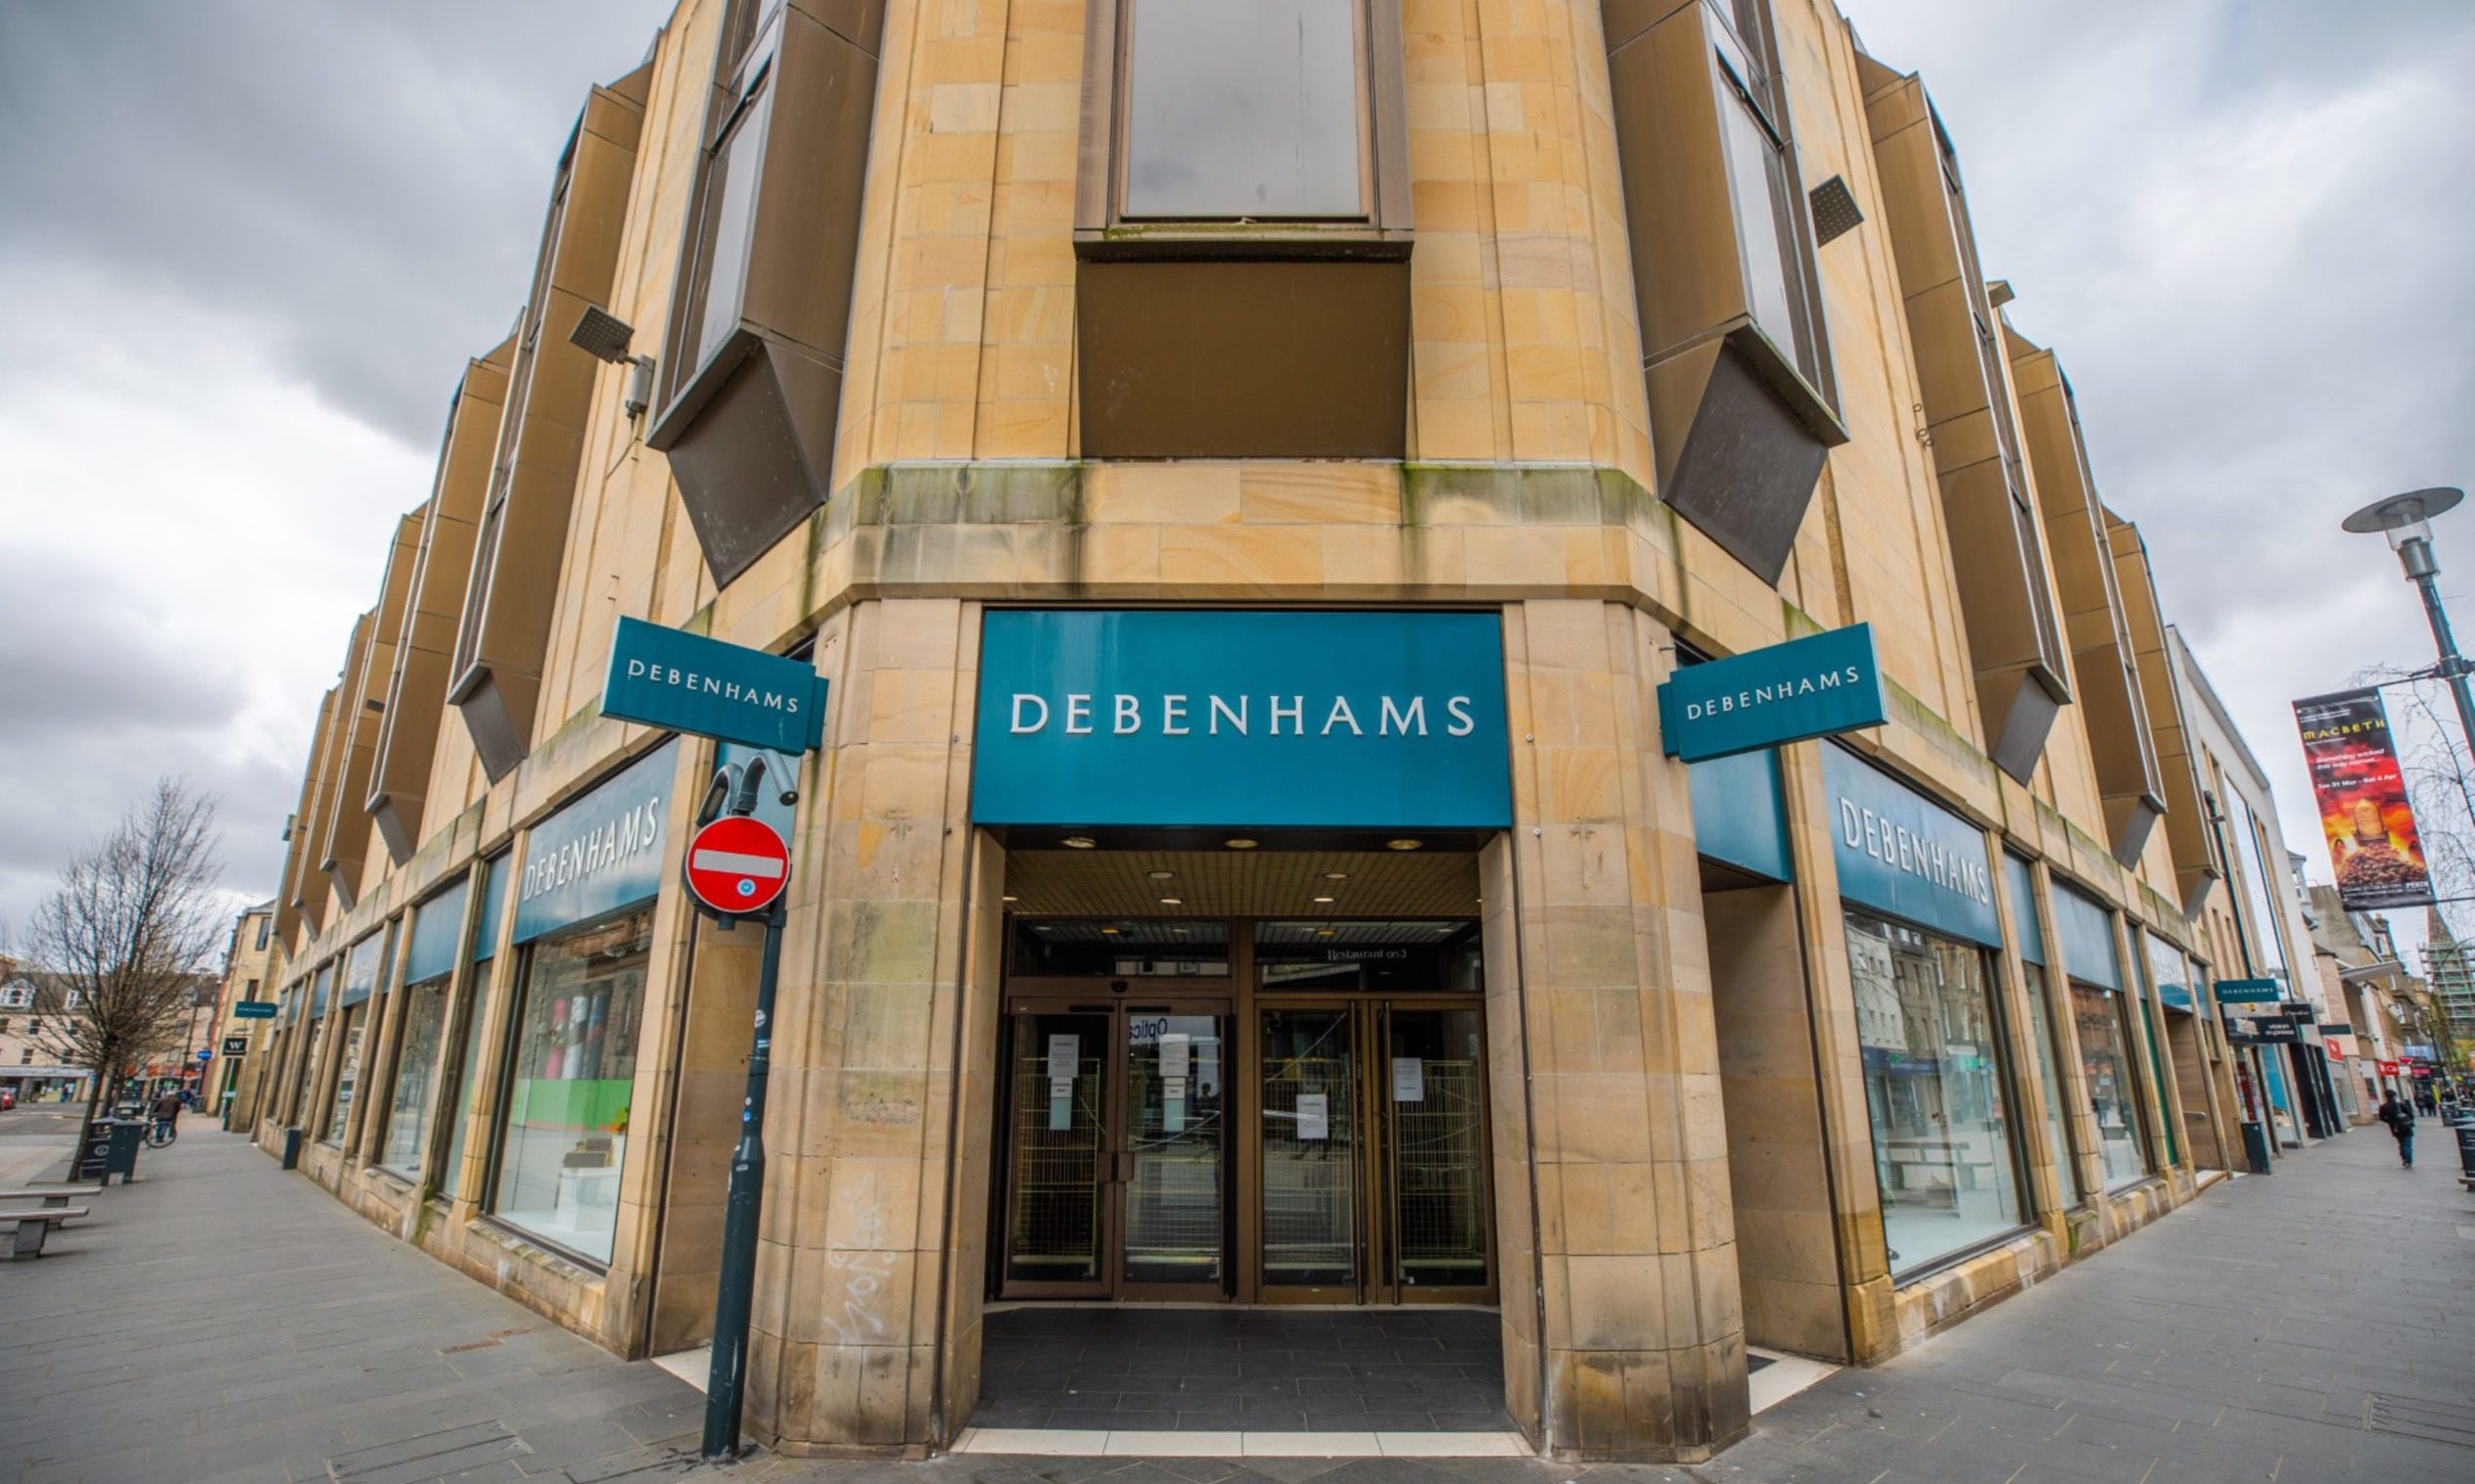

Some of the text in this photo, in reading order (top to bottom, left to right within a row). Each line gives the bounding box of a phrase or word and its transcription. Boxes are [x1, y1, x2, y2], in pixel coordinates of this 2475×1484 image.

[629, 659, 799, 713] DEBENHAMS
[1687, 666, 1859, 720] DEBENHAMS
[1009, 693, 1474, 736] DEBENHAMS
[2303, 719, 2385, 740] MACBETH
[523, 796, 660, 903] DEBENHAMS
[1840, 797, 1988, 904] DEBENHAMS
